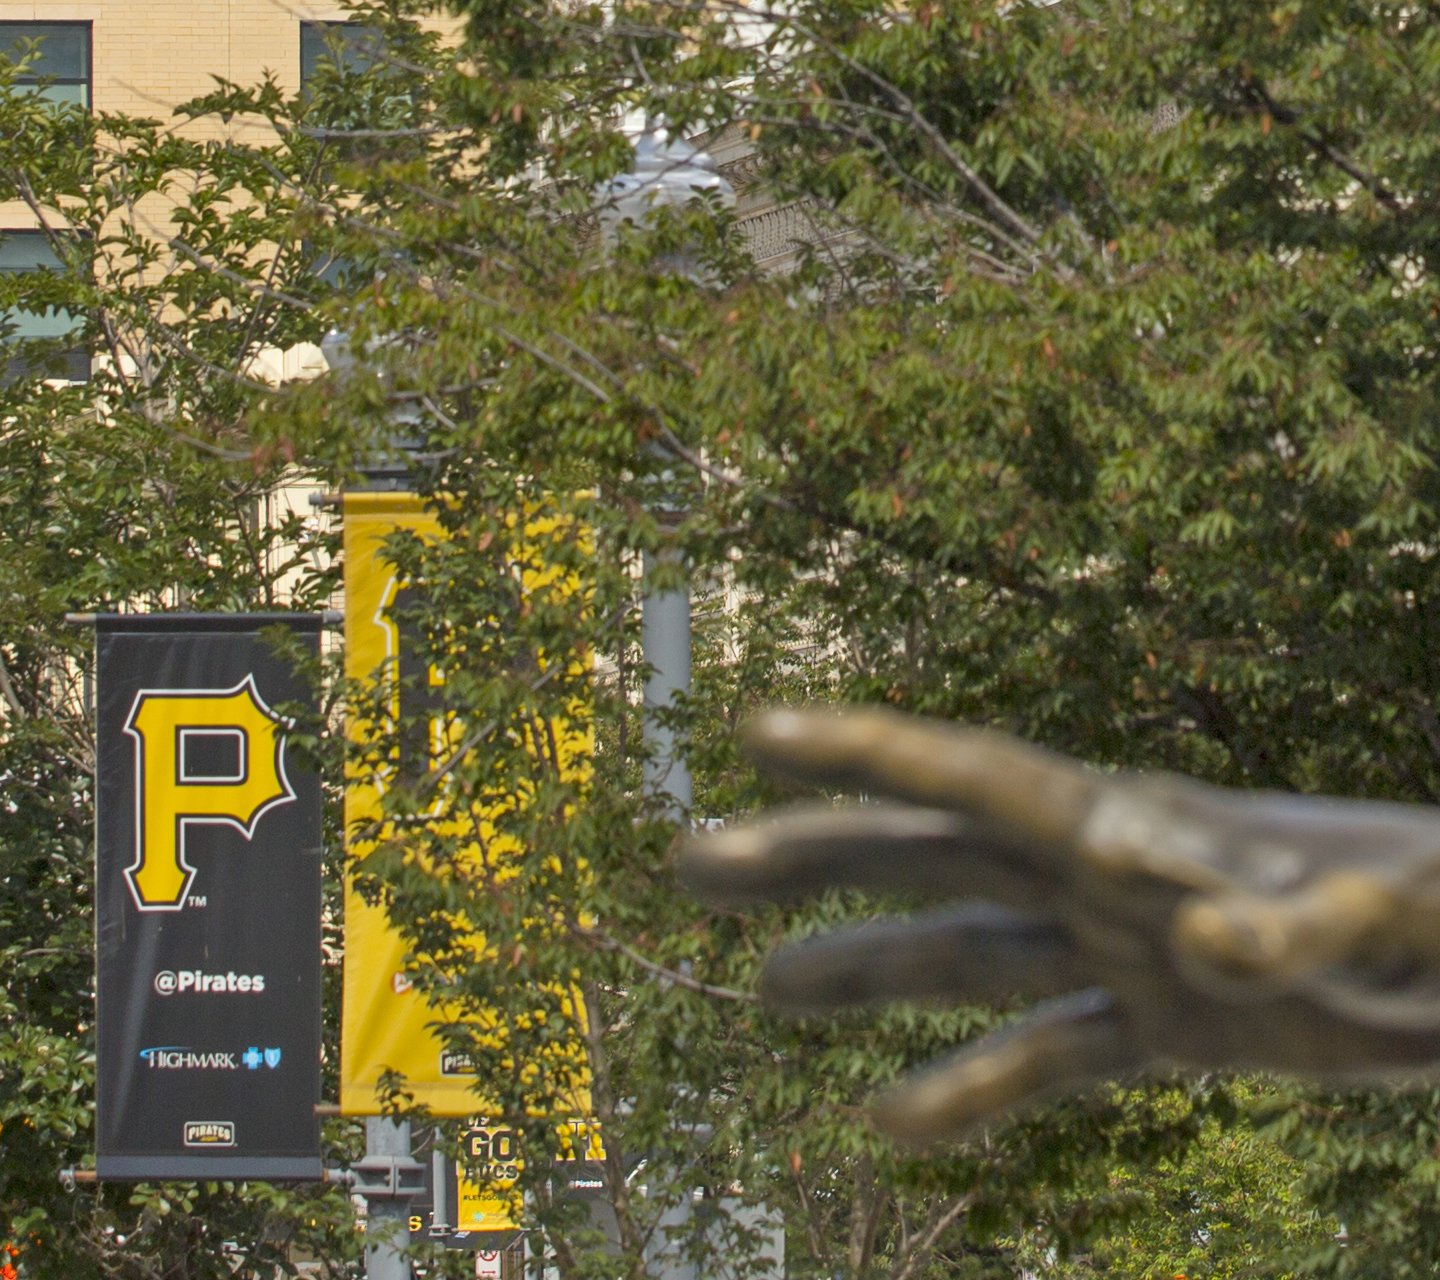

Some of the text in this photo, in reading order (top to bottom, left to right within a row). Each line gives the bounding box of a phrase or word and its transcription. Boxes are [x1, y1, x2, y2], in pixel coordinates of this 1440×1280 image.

[123, 672, 297, 911] P
[188, 896, 207, 907] TM
[154, 970, 265, 996] @Pirates
[463, 1127, 518, 1161] GO
